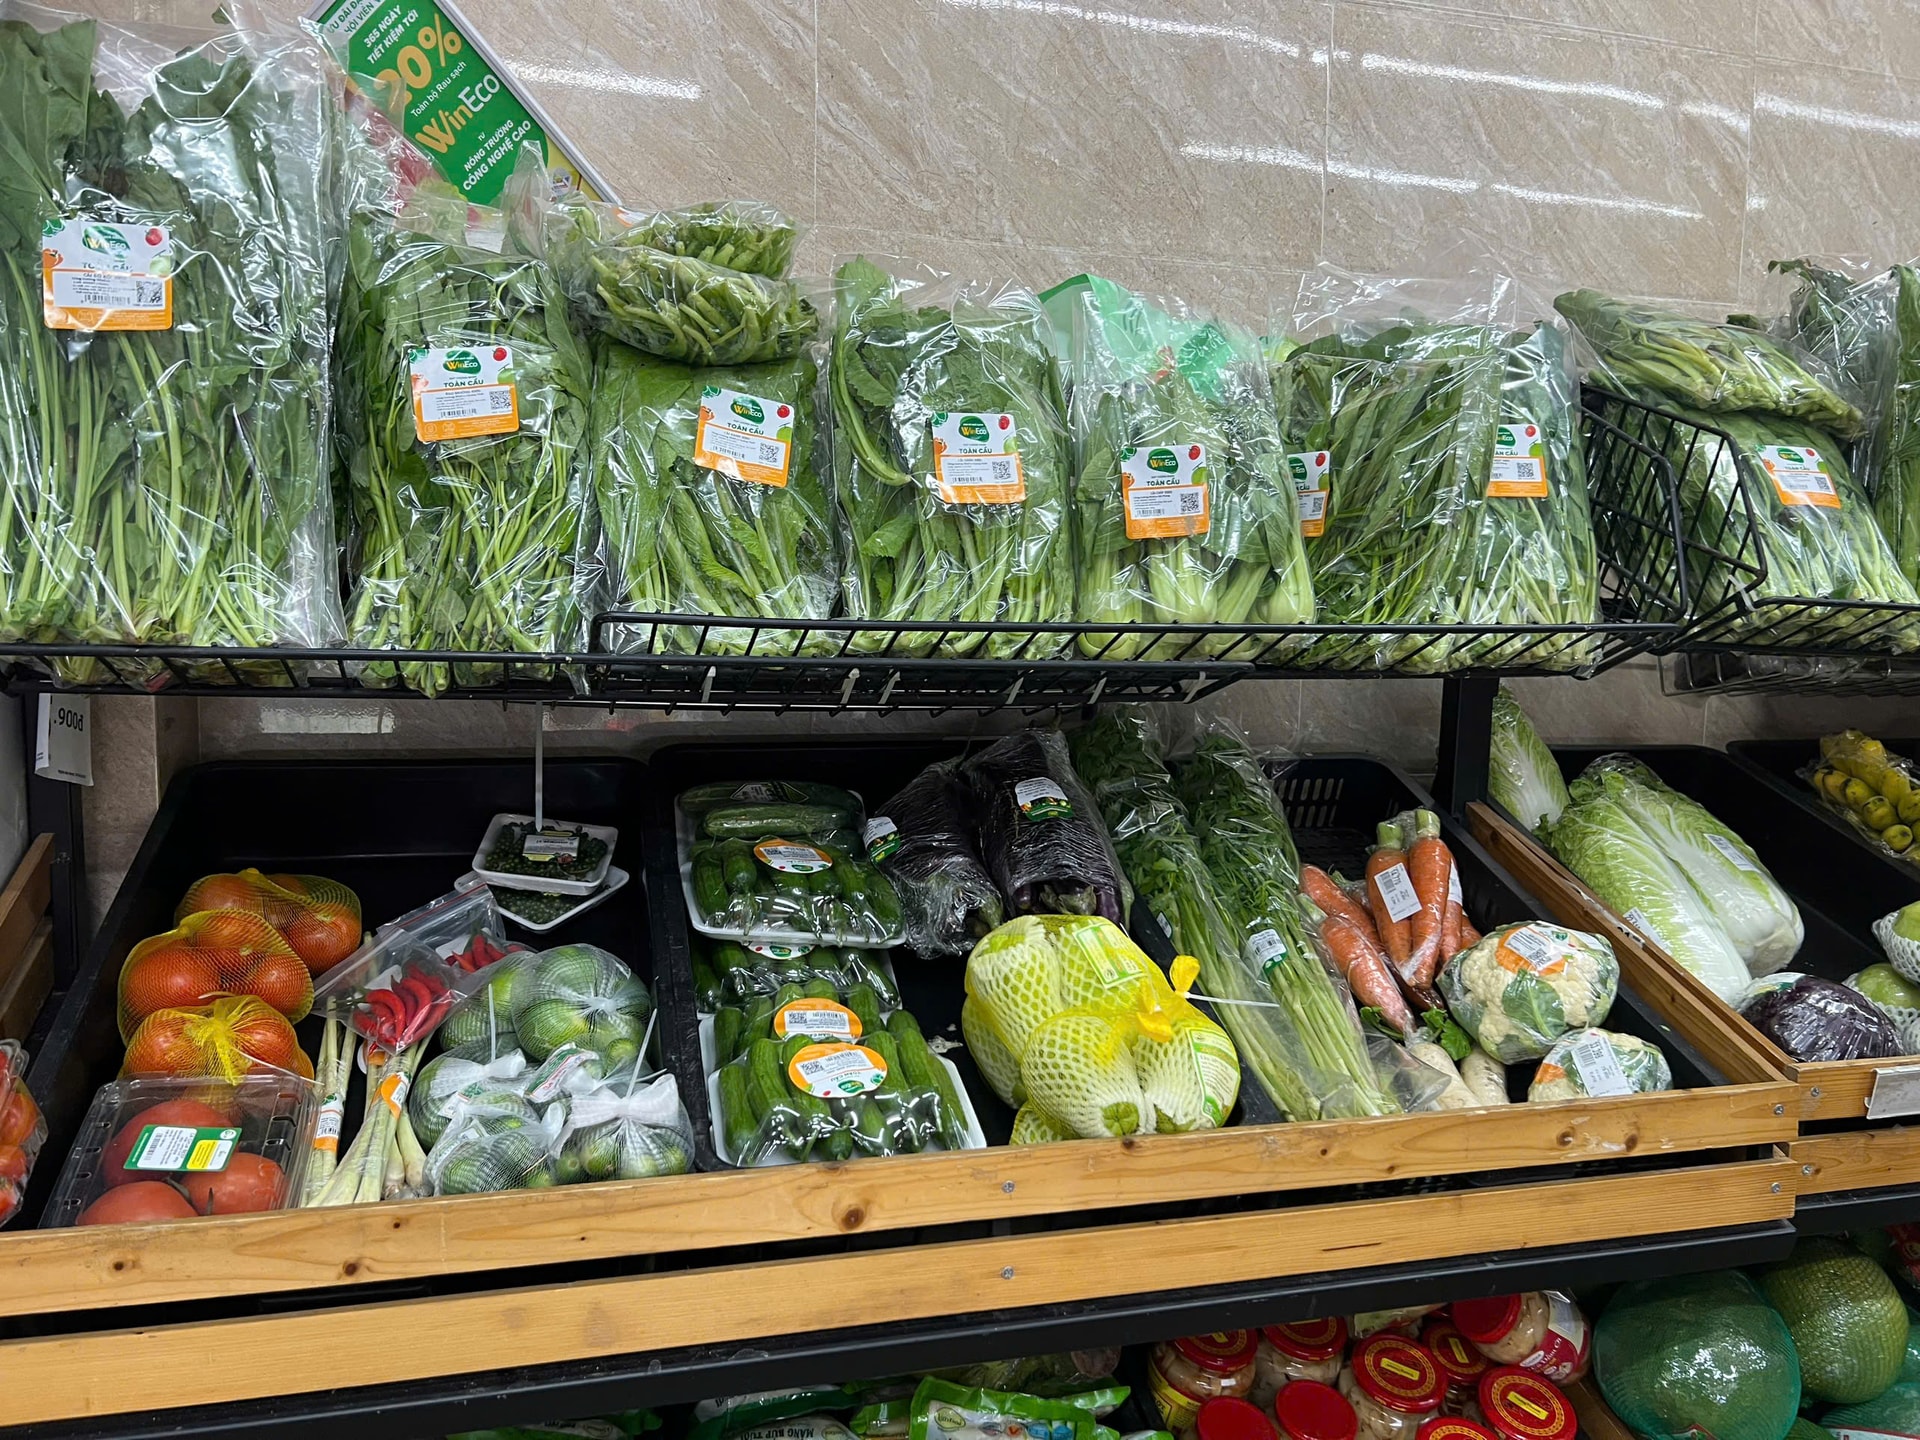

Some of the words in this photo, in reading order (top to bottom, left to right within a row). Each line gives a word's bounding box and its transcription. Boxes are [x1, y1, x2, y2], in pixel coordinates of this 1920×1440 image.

[356, 2, 375, 20] VIÊN
[364, 29, 381, 48] 365
[378, 5, 402, 33] NGÀY
[367, 46, 385, 64] TIẾT
[383, 25, 405, 49] KIỆM
[403, 9, 418, 27] TỚI
[411, 100, 430, 118] Toàn
[428, 89, 438, 102] bộ
[436, 77, 452, 93] Rau
[450, 60, 467, 80] sạch
[464, 147, 486, 172] NÔNG
[484, 120, 514, 150] TRƯỜNG
[462, 164, 489, 190] CÔNG
[488, 136, 514, 167] NGHỆ
[512, 120, 531, 142] CAO
[446, 360, 478, 370] WinEco
[444, 380, 467, 388] TOÀN
[733, 404, 762, 418] WinEco
[727, 422, 748, 432] TOÀN
[961, 427, 987, 436] WinEco
[1150, 458, 1176, 468] WinEco
[1146, 478, 1166, 486] TOÀN
